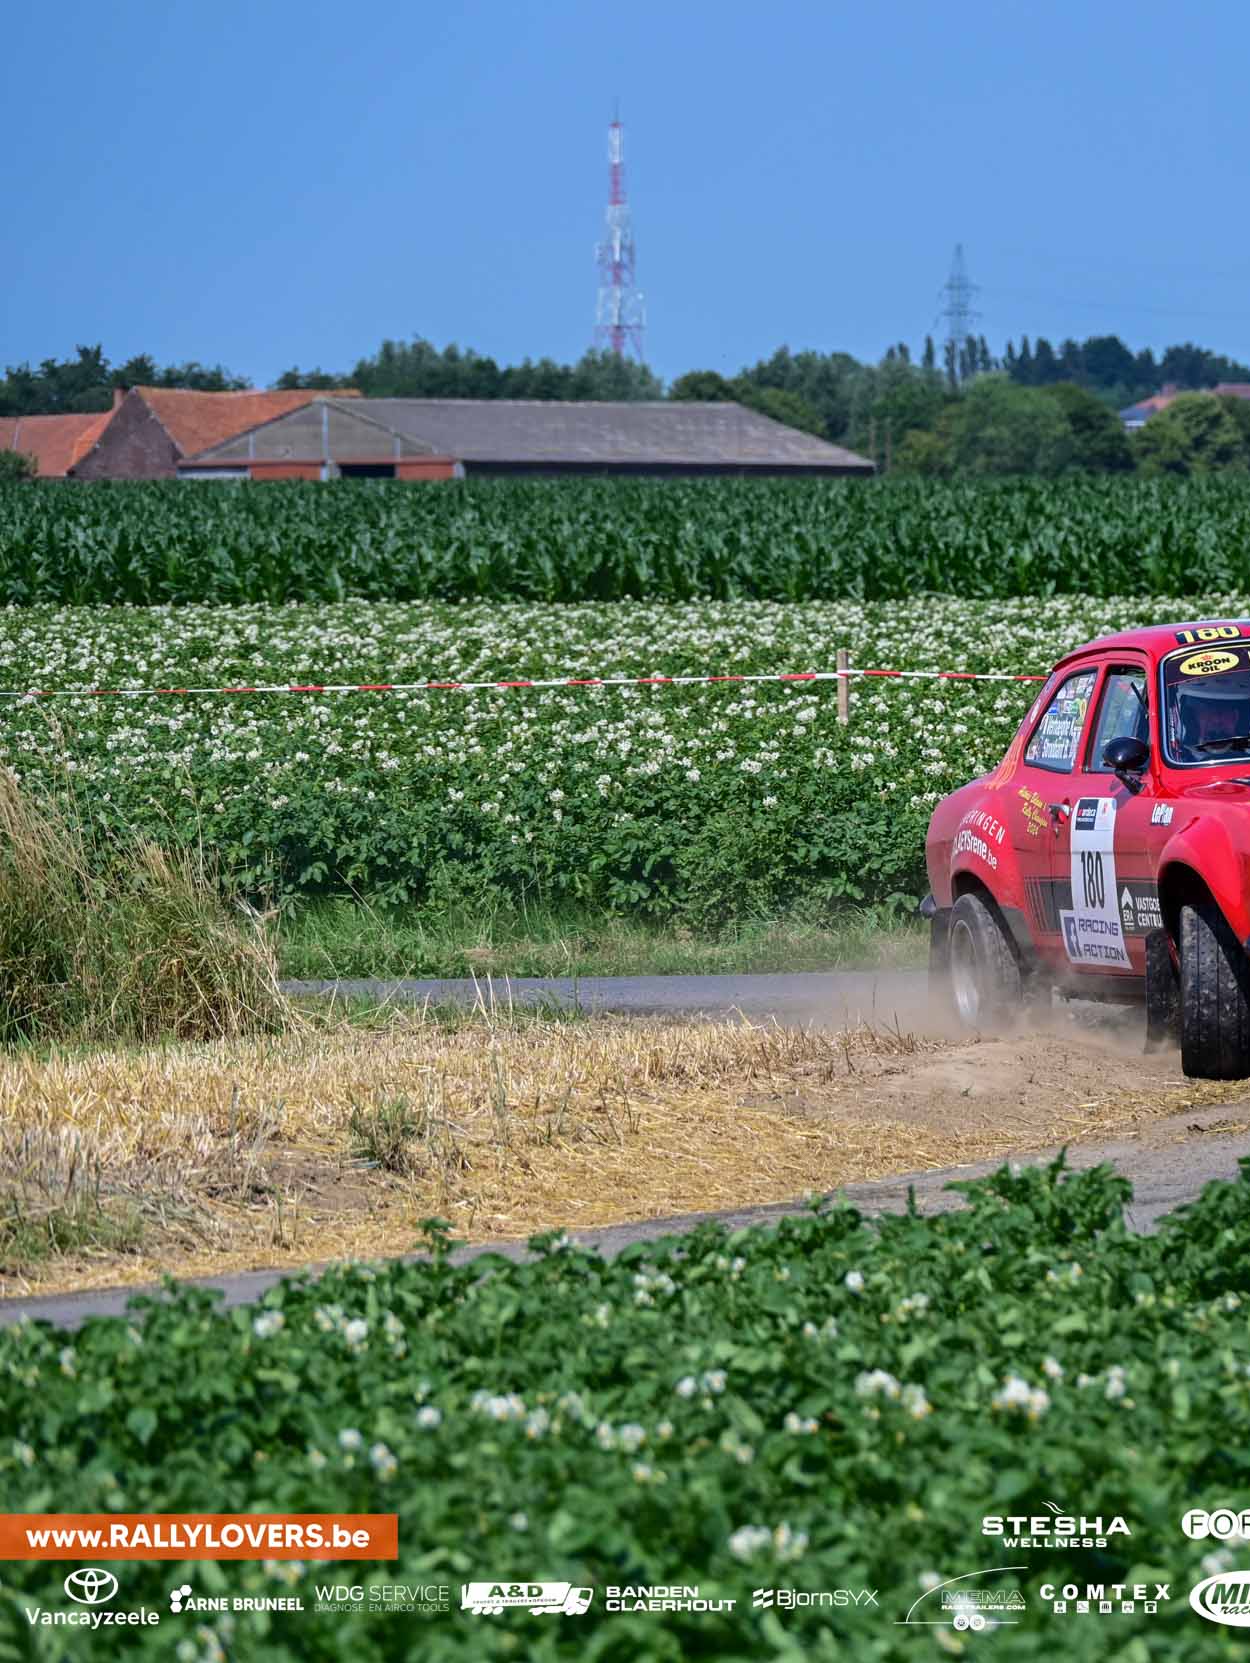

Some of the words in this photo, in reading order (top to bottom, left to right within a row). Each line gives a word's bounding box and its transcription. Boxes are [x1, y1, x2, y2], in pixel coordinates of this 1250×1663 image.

[1176, 626, 1240, 643] 180
[1188, 658, 1230, 670] KROON
[1201, 665, 1220, 673] OIL
[1081, 850, 1105, 909] 180
[1078, 918, 1119, 936] RACING
[1083, 943, 1126, 961] ACTION
